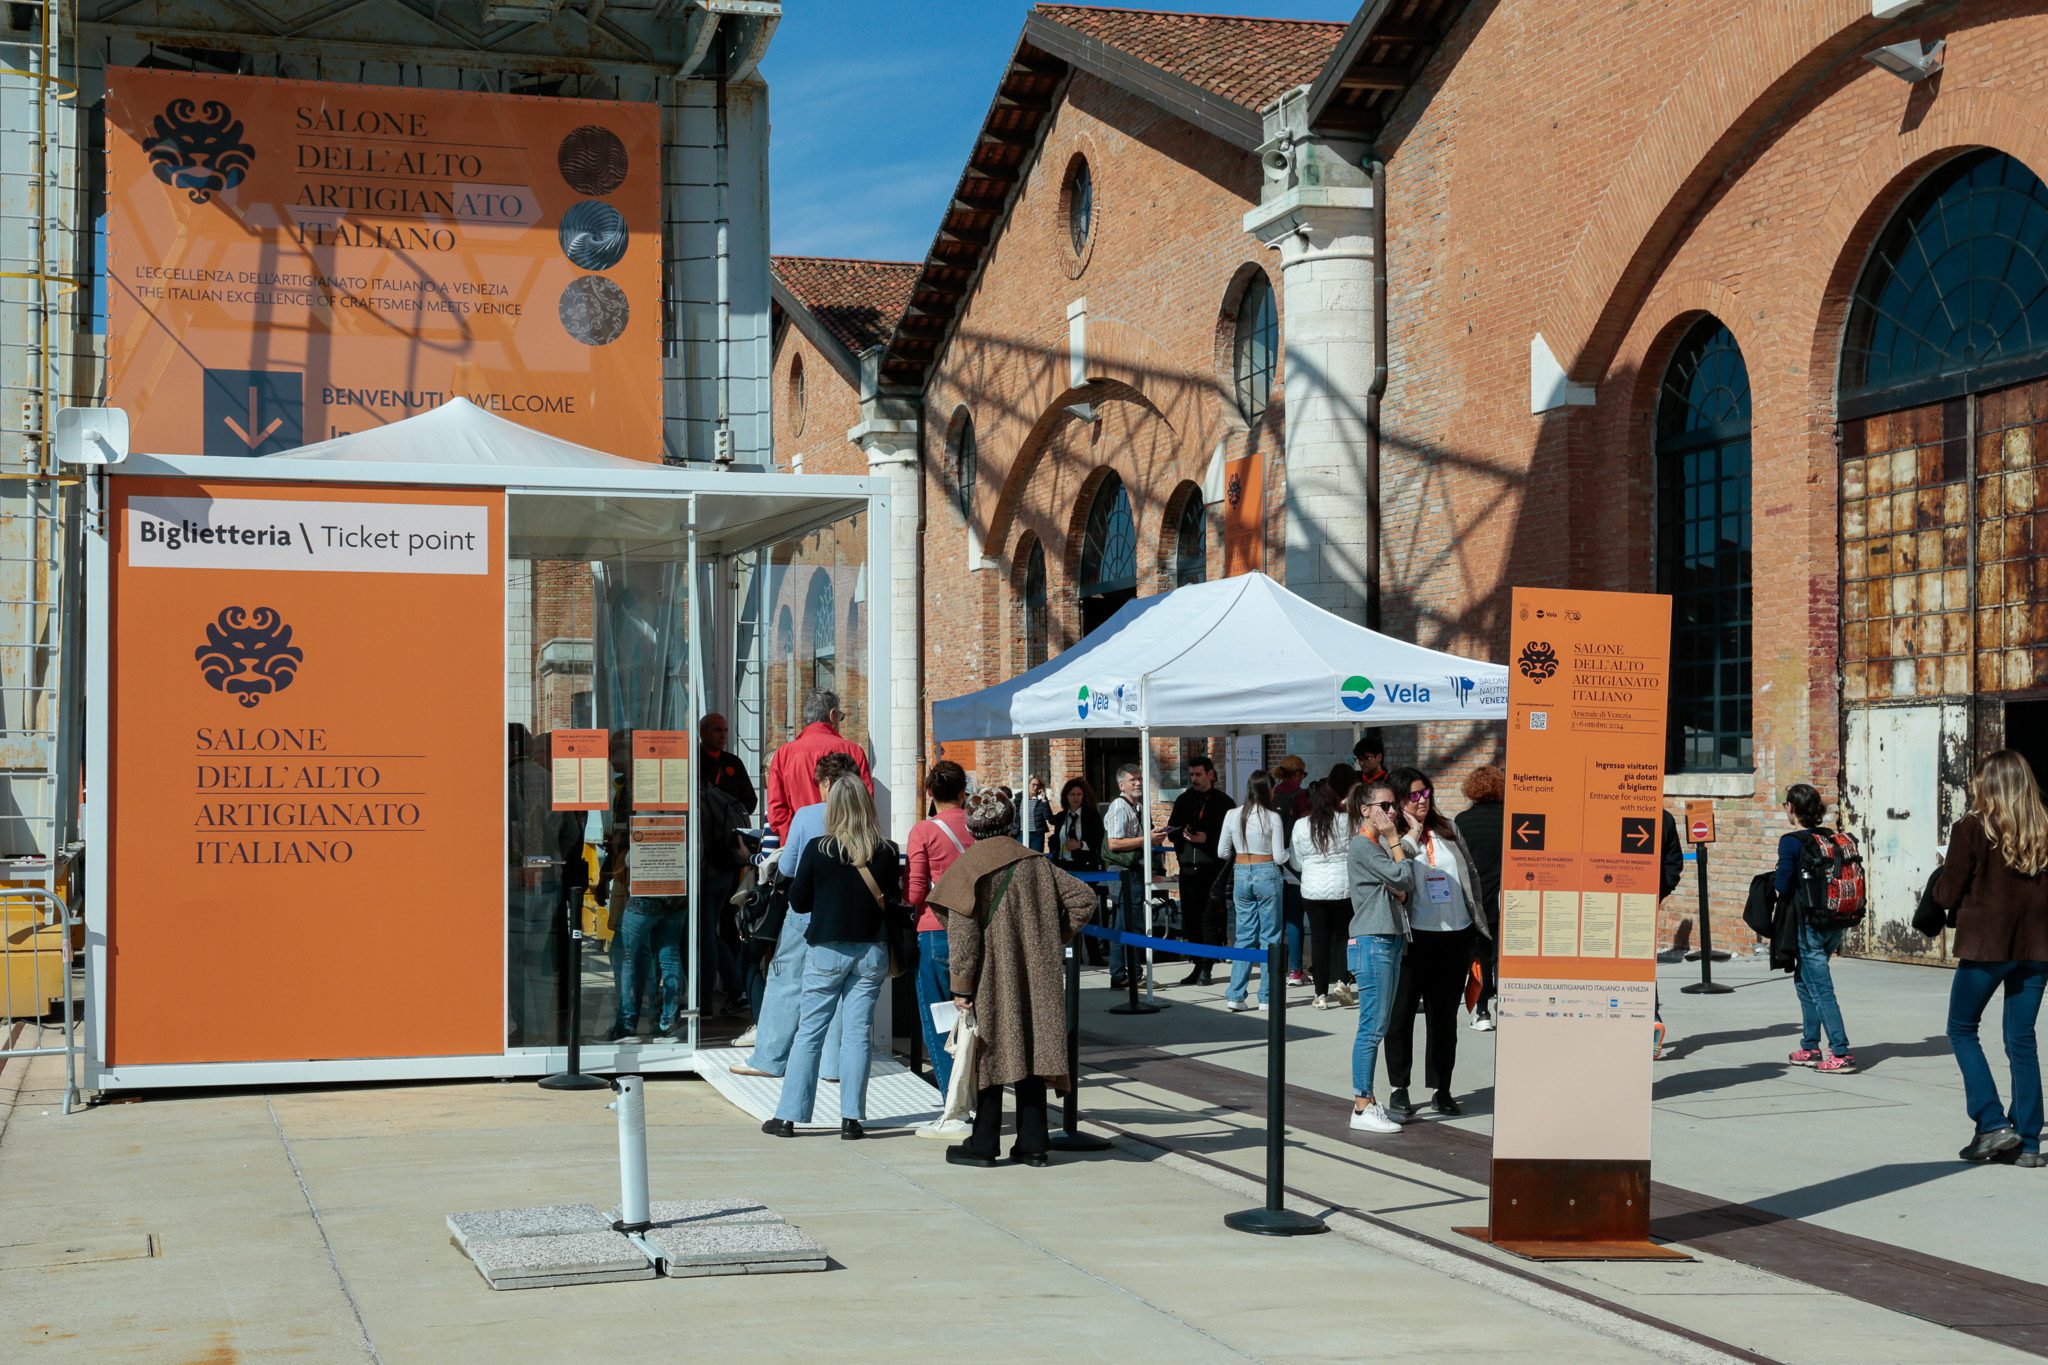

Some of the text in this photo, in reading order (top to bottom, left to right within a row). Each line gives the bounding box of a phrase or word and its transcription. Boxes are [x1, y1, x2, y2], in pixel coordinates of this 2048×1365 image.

[296, 107, 428, 137] SALONE
[298, 145, 482, 177] DELL'ALTO
[295, 184, 523, 217] ARTIGIANATO
[298, 222, 456, 251] ITALIANO
[136, 266, 509, 296] L'ECCELLENZA DELL'ARTIGIANATO ITALIANO A VENEZIA
[136, 286, 522, 315] THE ITALIAN EXCELLENCE OF CRAFTSMEN MEETS VENICE
[322, 388, 575, 414] BENVENUTI WELCOME
[140, 519, 292, 550] Biglietteria
[321, 524, 400, 549] Ticket
[408, 530, 476, 556] point
[1574, 643, 1625, 655] SALONE
[1572, 675, 1659, 688] ARTIGIANATO
[1384, 684, 1430, 703] Vela
[1479, 687, 1508, 695] NAUTIC
[1573, 690, 1633, 702] ITALIANO
[1571, 709, 1598, 718] Arsenale
[1607, 711, 1632, 719] Venezia
[1584, 721, 1608, 729] ottobre
[196, 728, 327, 751] SALONE
[1595, 761, 1658, 771] Ingresso visitatori
[196, 766, 380, 789] DELL'ALTO
[1513, 773, 1552, 783] Biglietteria
[1636, 773, 1658, 781] dotati
[1513, 784, 1554, 793] Ticket point
[1627, 783, 1657, 792] biglietto
[1590, 792, 1657, 802] Entrance for visitors
[194, 803, 420, 826] ARTIGIANATO
[1620, 804, 1656, 813] with ticket
[196, 840, 353, 864] ITALIANO
[1504, 982, 1542, 990] L'ECCELLENZA
[1594, 984, 1620, 992] ITALIANO
